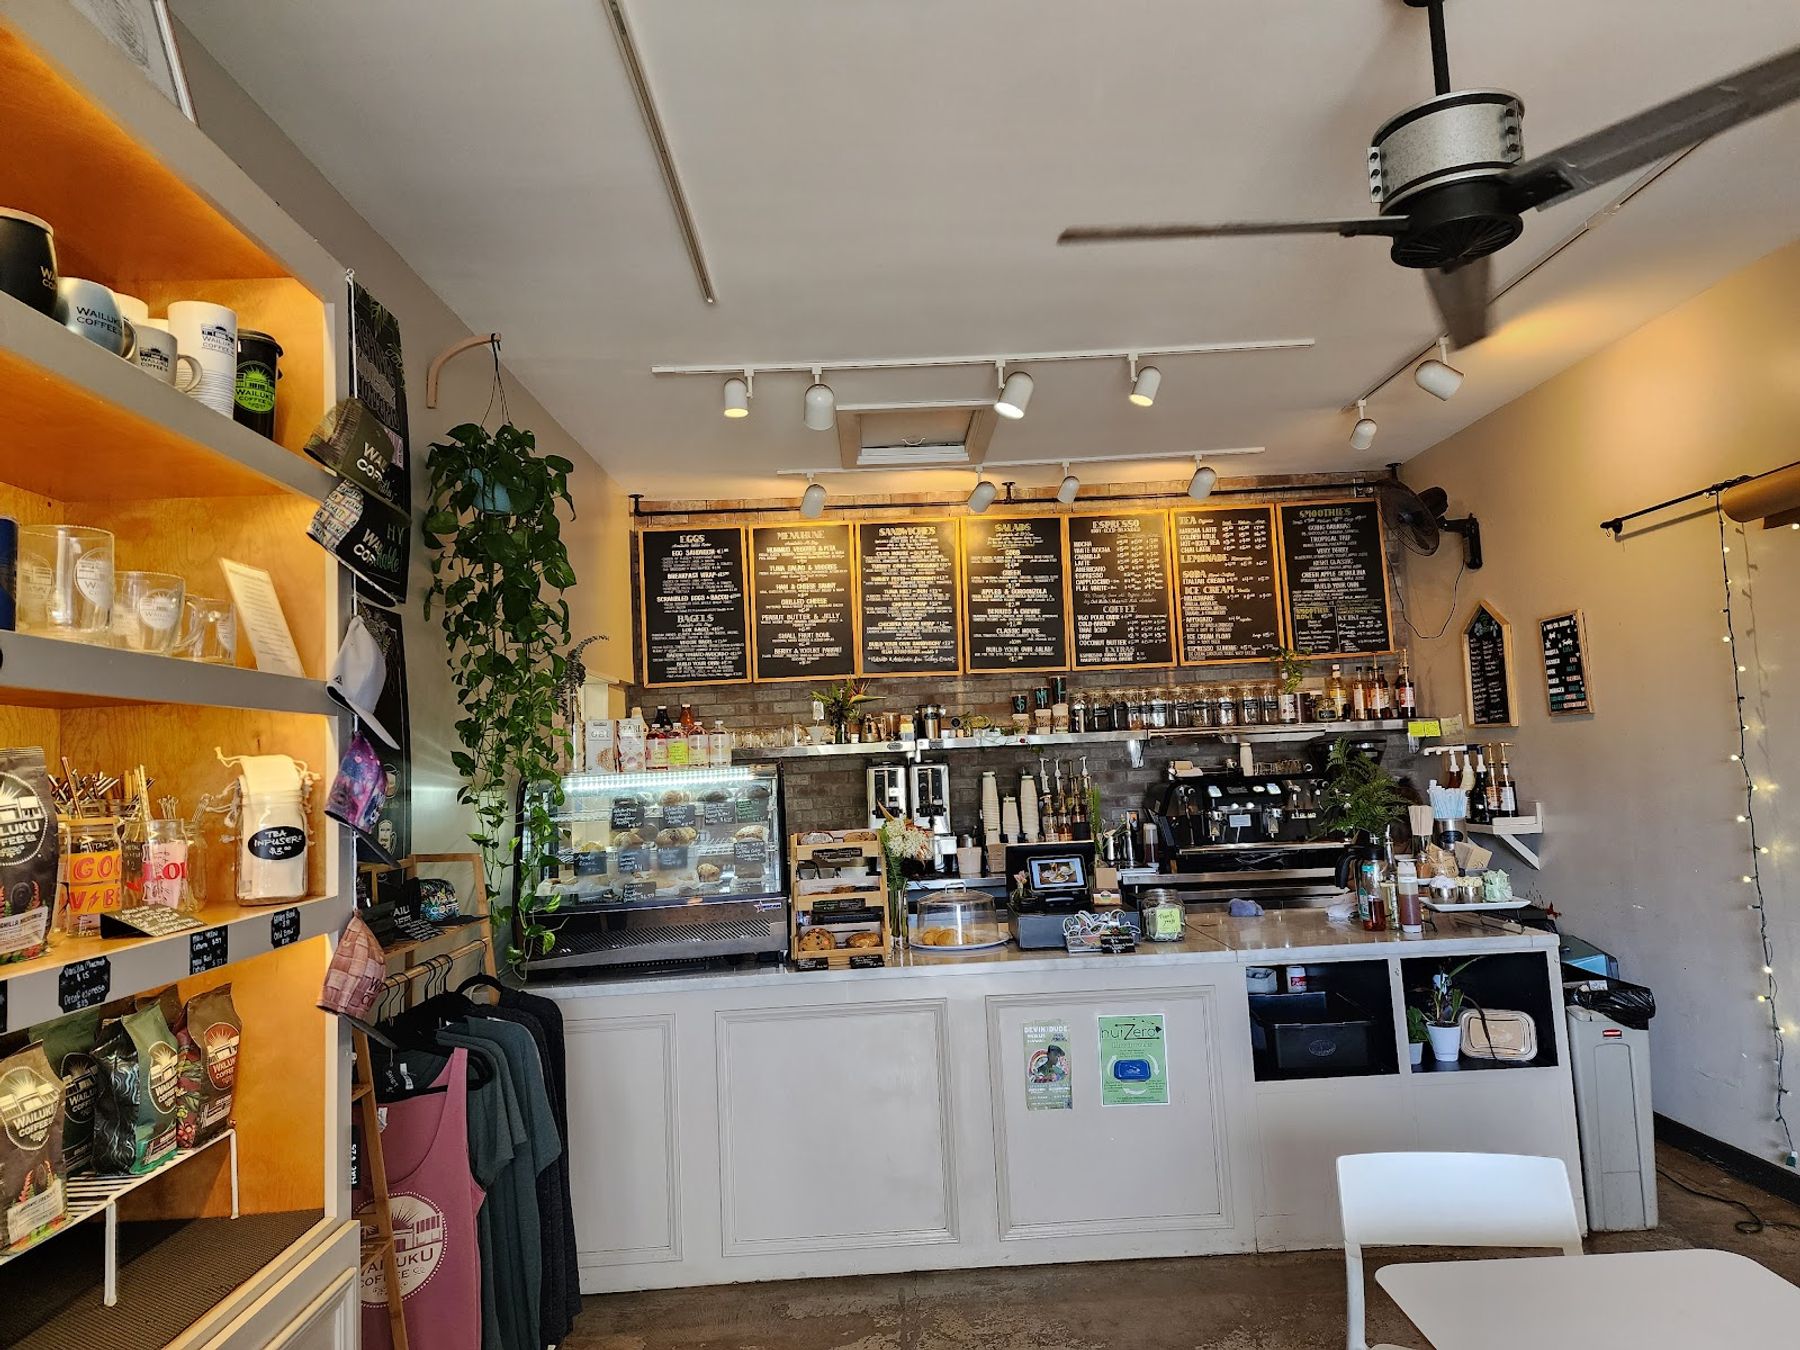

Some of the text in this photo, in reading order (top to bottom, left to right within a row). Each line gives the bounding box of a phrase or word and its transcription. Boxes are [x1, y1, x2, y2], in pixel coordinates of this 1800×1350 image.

[1300, 508, 1352, 518] SMOOTHIES
[1092, 520, 1139, 529] ESPRESSO
[1179, 517, 1197, 525] TEA
[878, 527, 936, 536] SANDWICHES
[994, 523, 1031, 532] SALADS
[680, 535, 705, 543] EGGS
[1180, 554, 1229, 563] LEMONADE
[1182, 570, 1206, 578] SODA
[1184, 585, 1235, 594] ICE CREAM
[1102, 605, 1137, 613] COFFEE
[677, 614, 714, 623] BAGELS
[1036, 690, 1048, 704] M
[265, 830, 287, 838] TEA
[64, 965, 85, 977] Vanilla
